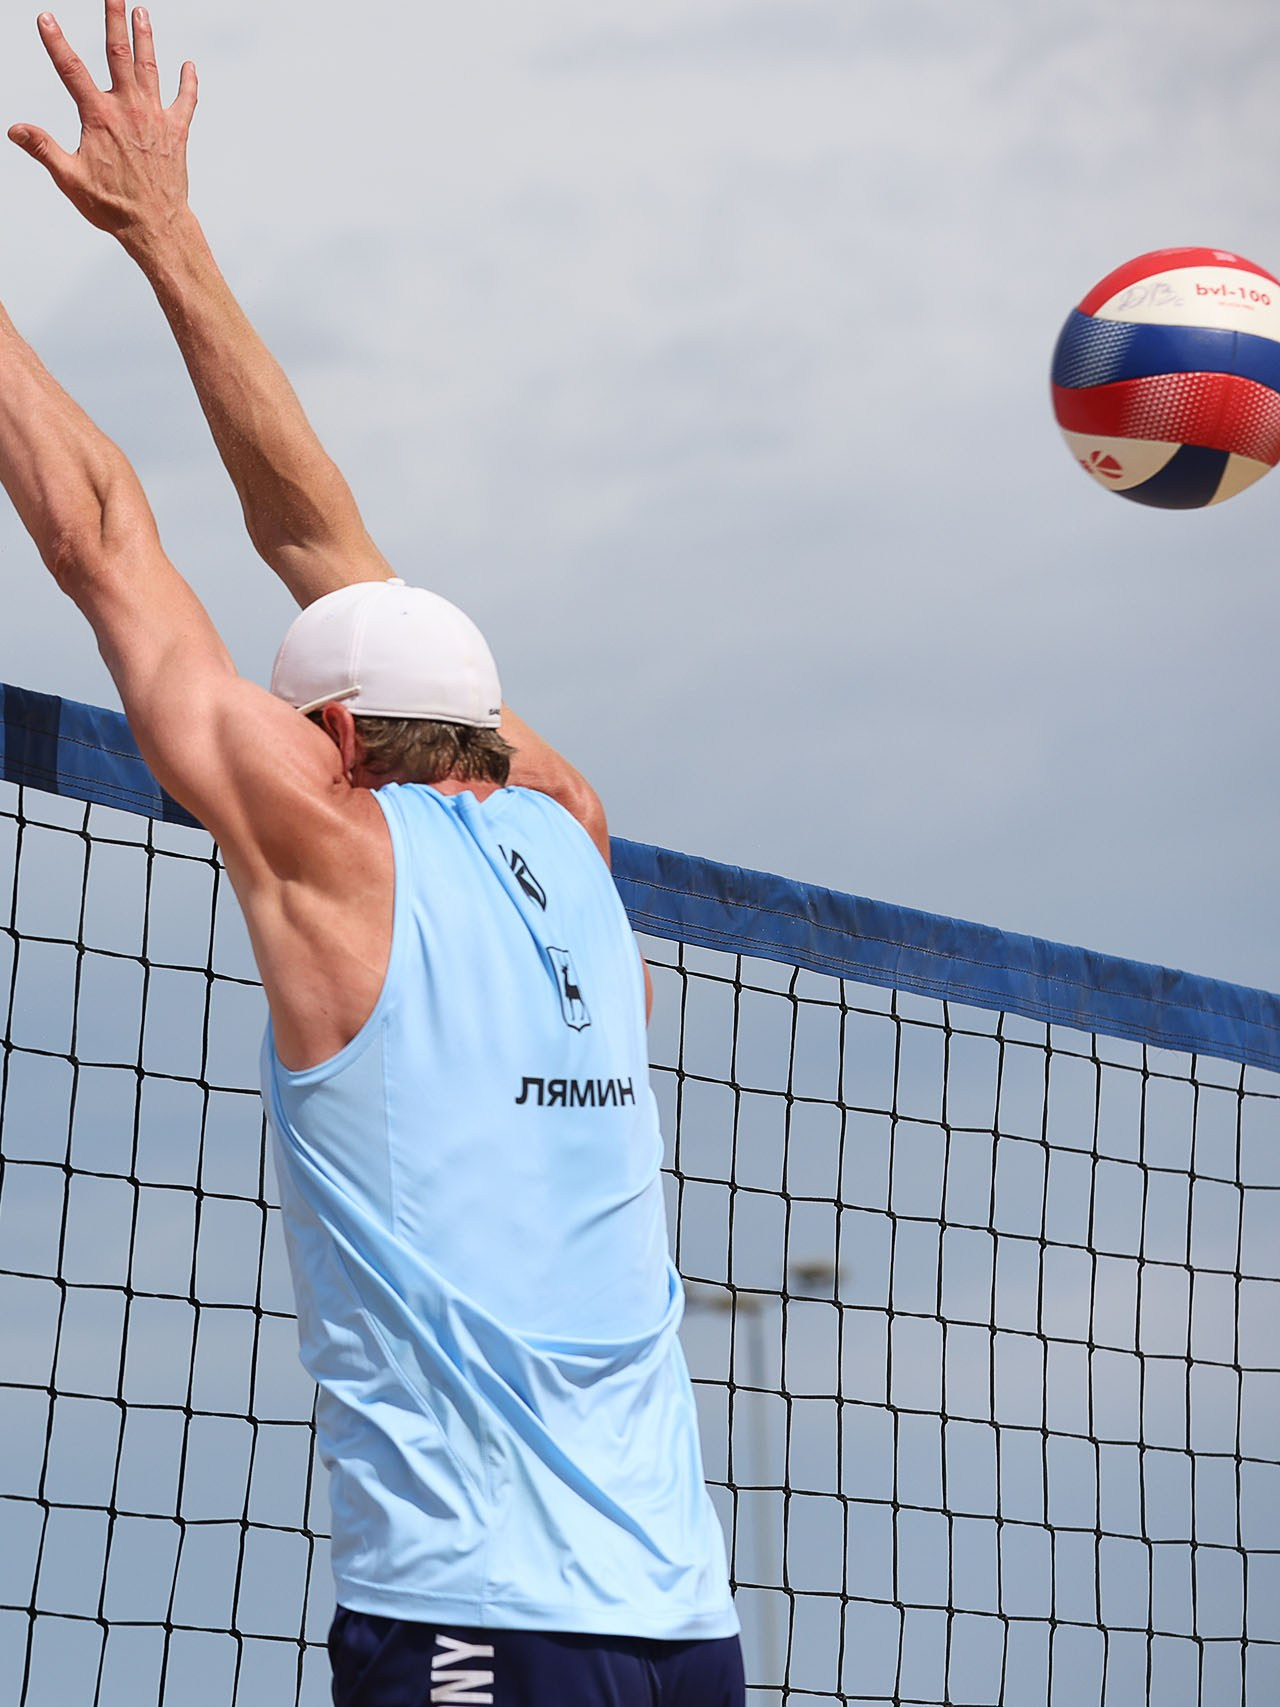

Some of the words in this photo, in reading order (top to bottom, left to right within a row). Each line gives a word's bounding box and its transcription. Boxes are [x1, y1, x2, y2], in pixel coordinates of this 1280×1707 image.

[1195, 283, 1271, 306] bvl-100
[515, 1076, 636, 1107] ЛЯМИН
[430, 1633, 495, 1707] NY
